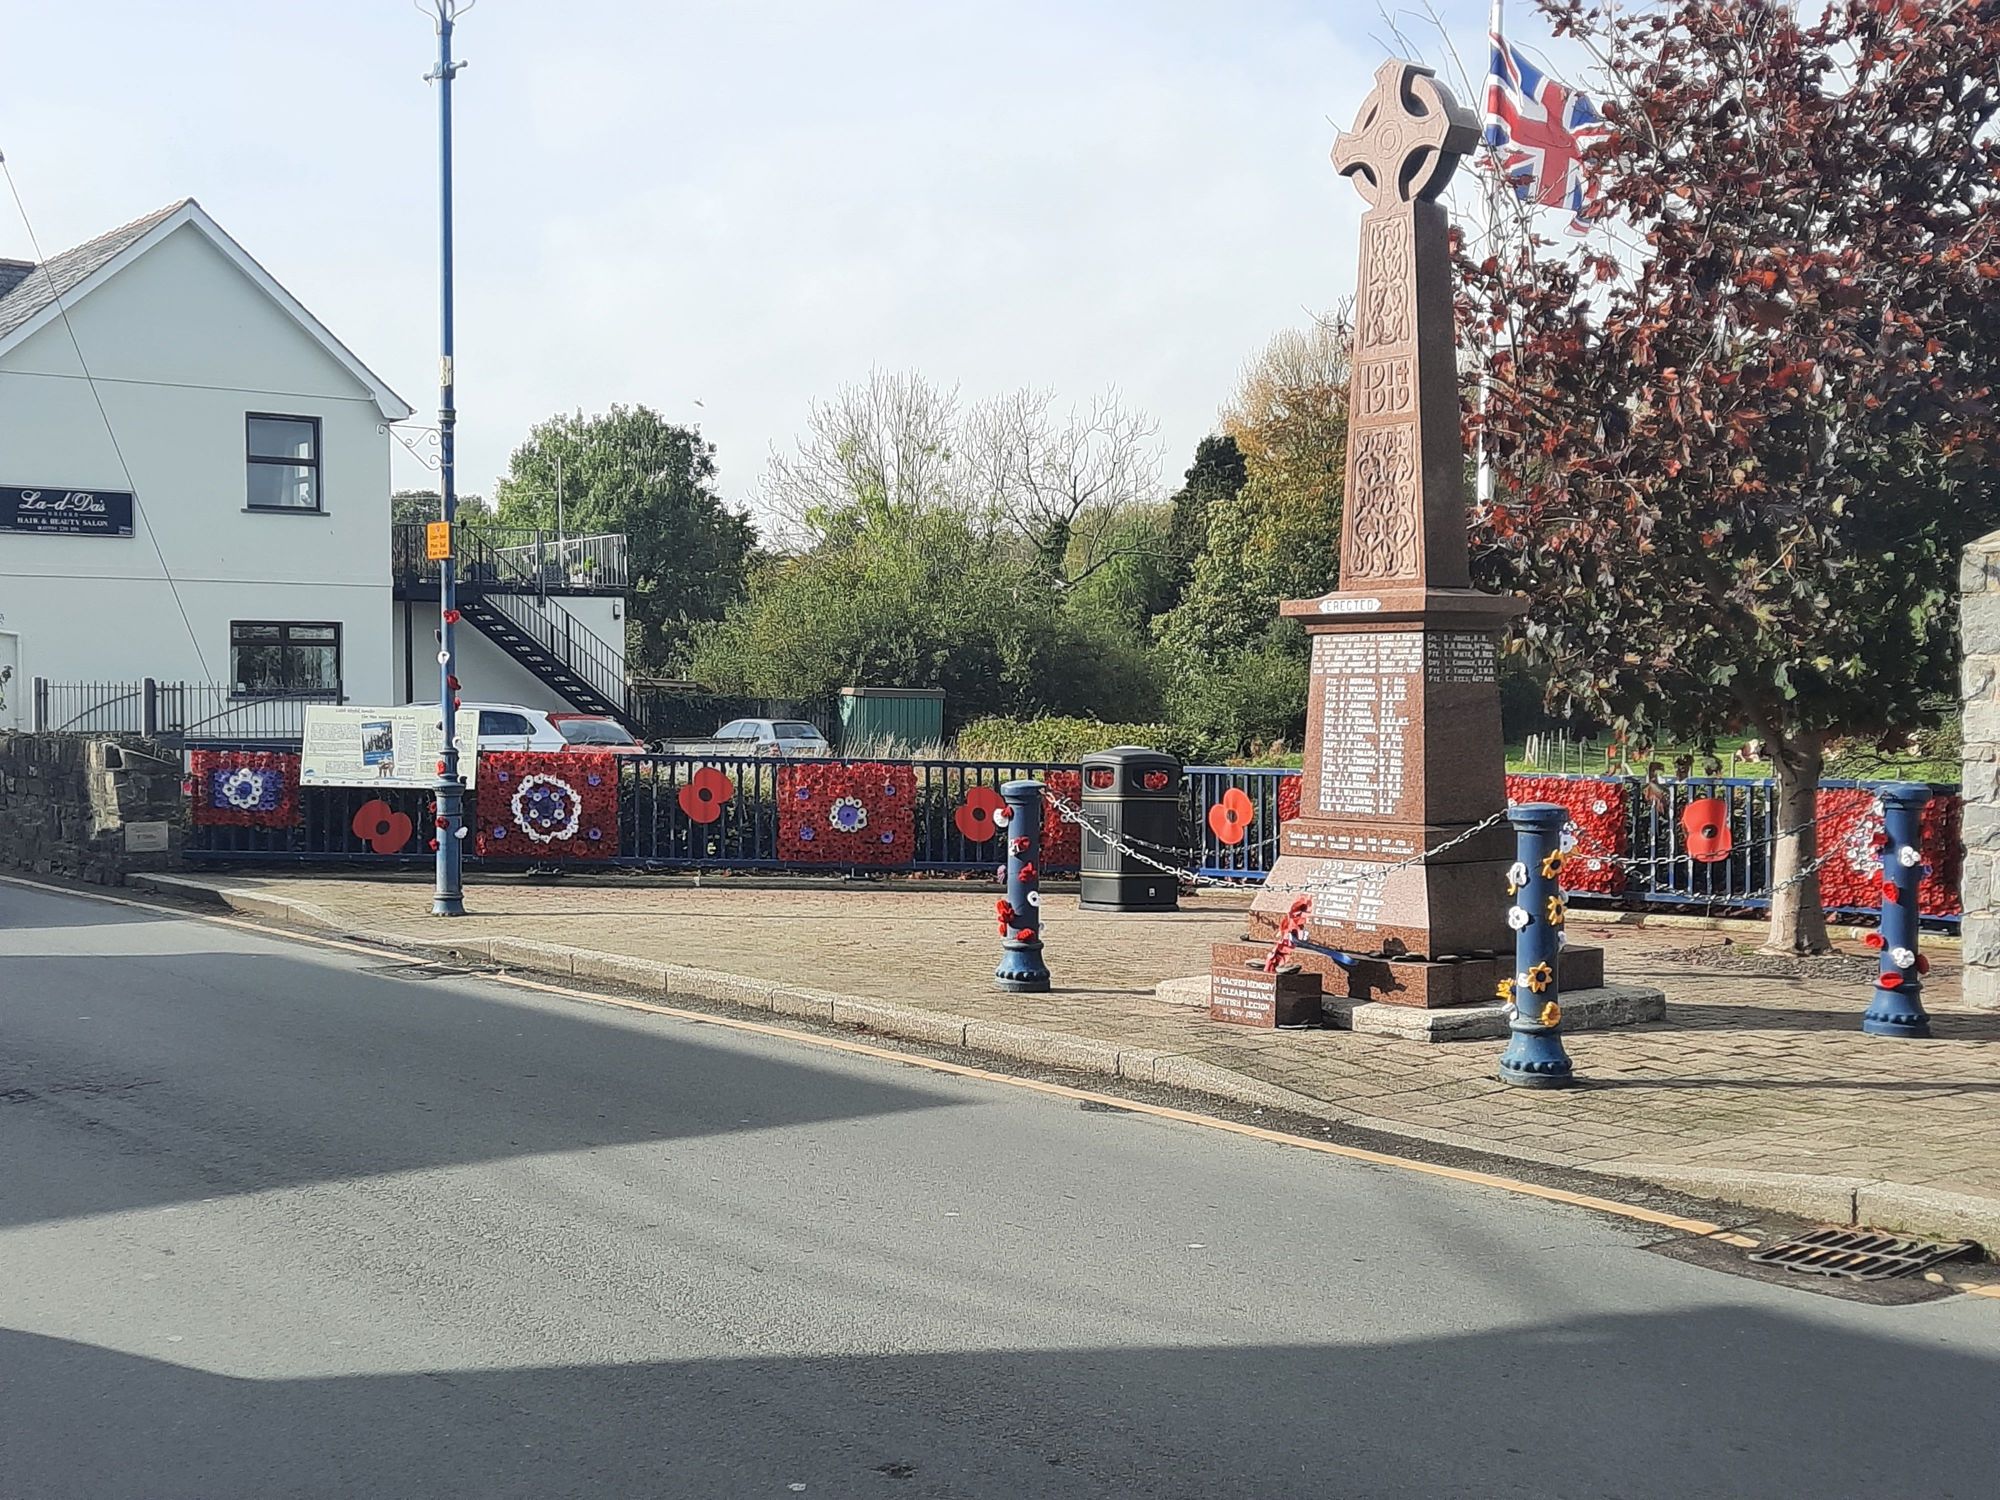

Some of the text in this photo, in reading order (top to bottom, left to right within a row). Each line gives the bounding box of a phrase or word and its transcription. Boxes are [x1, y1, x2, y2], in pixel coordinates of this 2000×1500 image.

[1364, 360, 1409, 390] 1914
[1364, 386, 1409, 414] 1919
[1327, 599, 1373, 611] ERECTED
[1322, 861, 1343, 871] 1939
[1221, 977, 1246, 987] SACRED
[1247, 979, 1274, 990] MEMORY
[1222, 987, 1248, 998] CLEARS
[1214, 996, 1270, 1010] BRITISH LEGION
